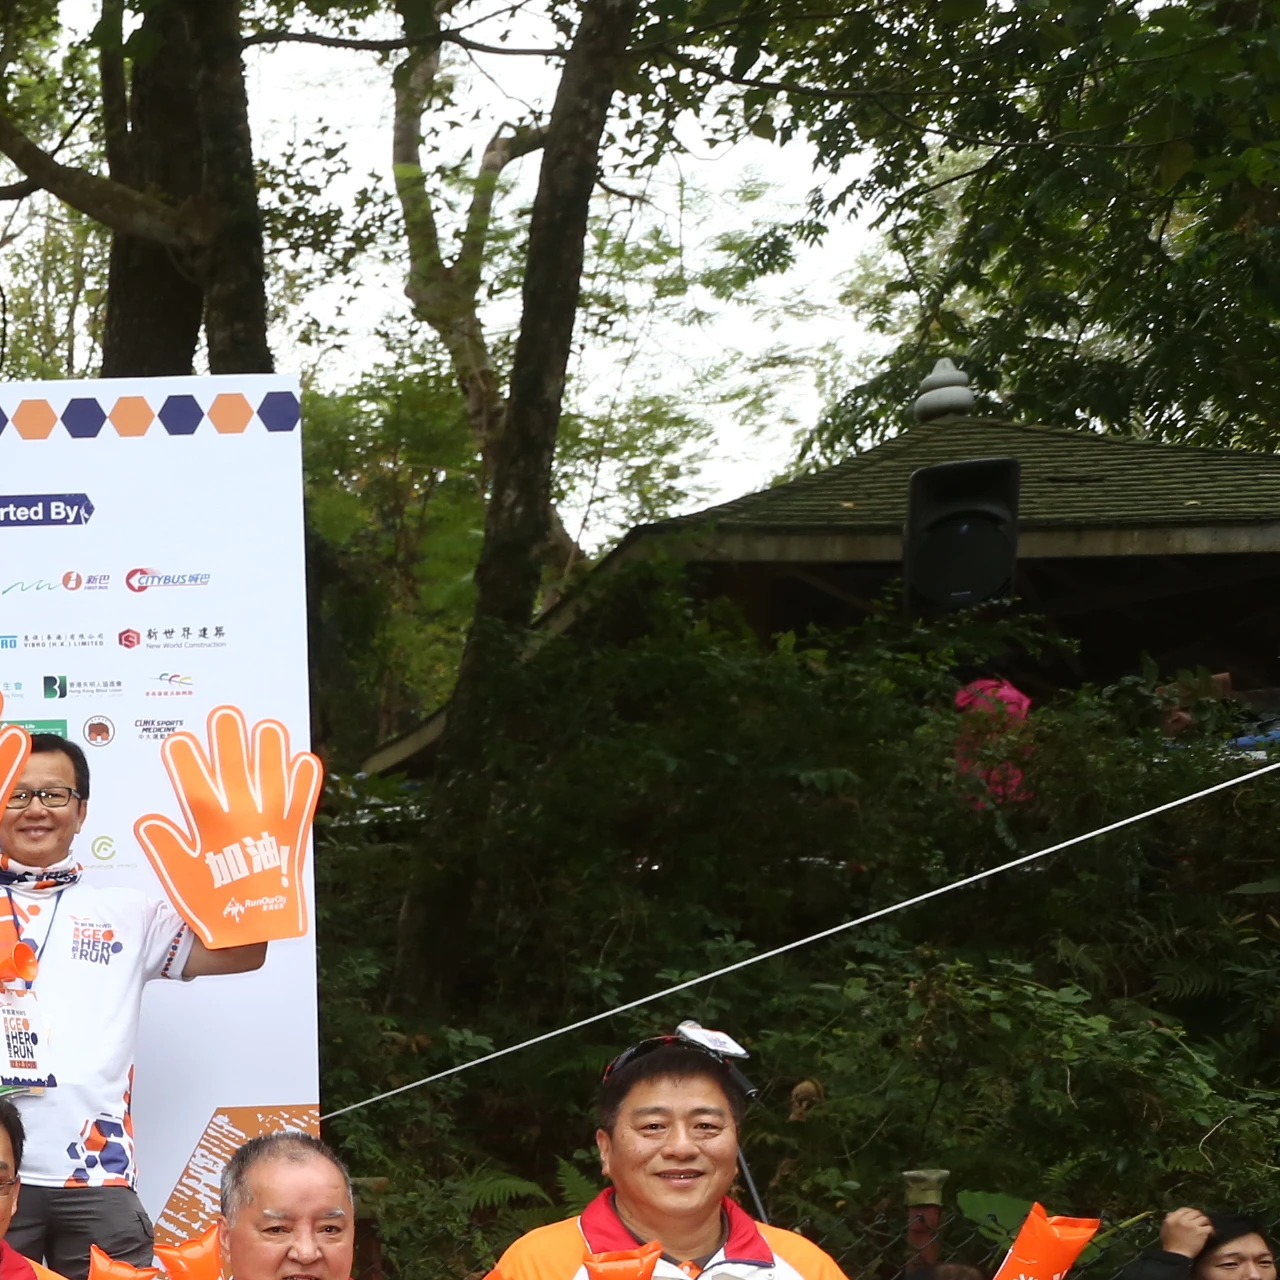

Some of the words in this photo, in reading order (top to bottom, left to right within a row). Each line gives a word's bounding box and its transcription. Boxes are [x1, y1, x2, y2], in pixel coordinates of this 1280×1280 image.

[51, 502, 80, 523] By
[137, 574, 187, 586] CITYBUS
[156, 719, 184, 727] SPORTS
[204, 830, 291, 889] 加油!
[245, 895, 287, 908] RunOurCity
[79, 948, 110, 966] RUN
[12, 1045, 35, 1059] RUN
